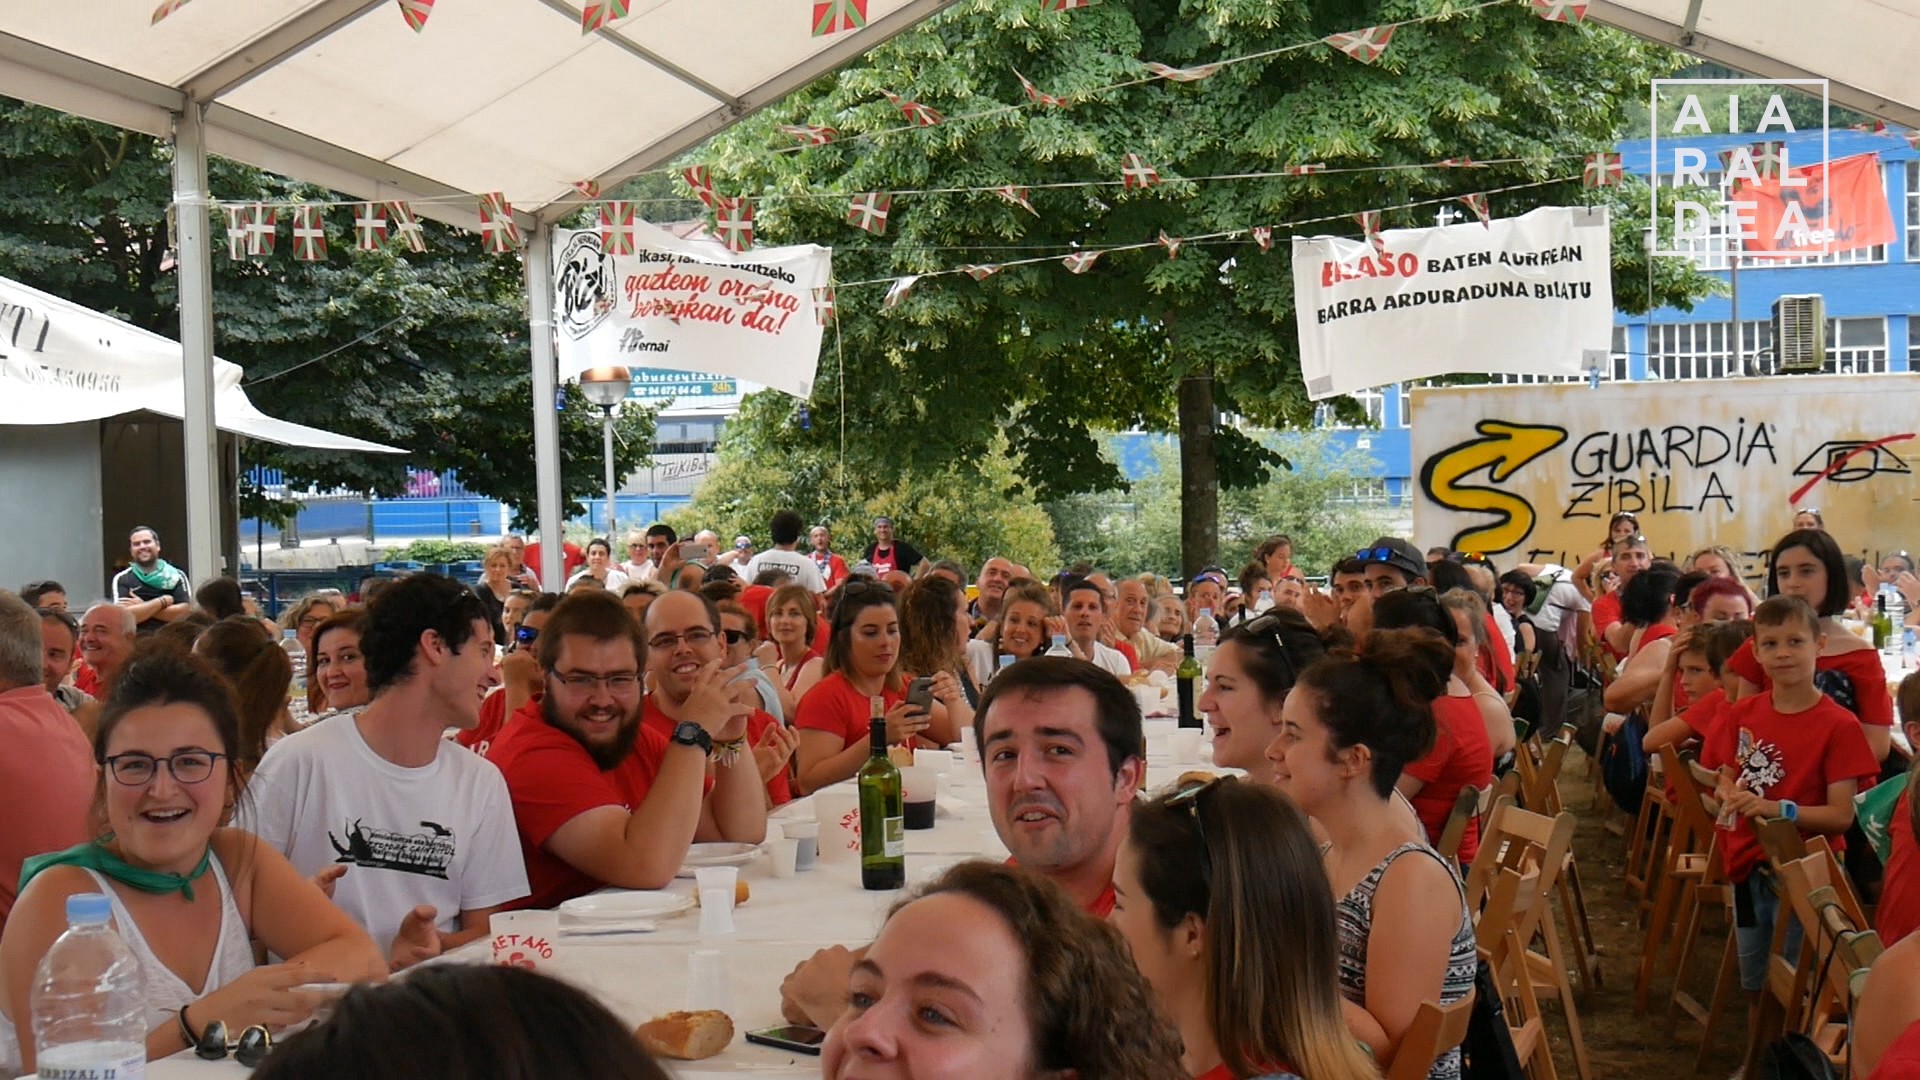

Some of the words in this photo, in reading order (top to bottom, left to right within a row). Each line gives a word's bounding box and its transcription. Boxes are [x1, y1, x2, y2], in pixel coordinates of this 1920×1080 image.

[1427, 250, 1492, 273] BATEN
[1499, 245, 1583, 267] AURREAN
[625, 264, 711, 302] gazteon
[1317, 296, 1377, 325] BARRA
[1383, 280, 1529, 311] ARDURADUNA
[1534, 281, 1592, 300] BILATU
[741, 304, 790, 335] da!
[1571, 416, 1777, 478] GUARDIA
[1562, 471, 1734, 519] ZIBILA
